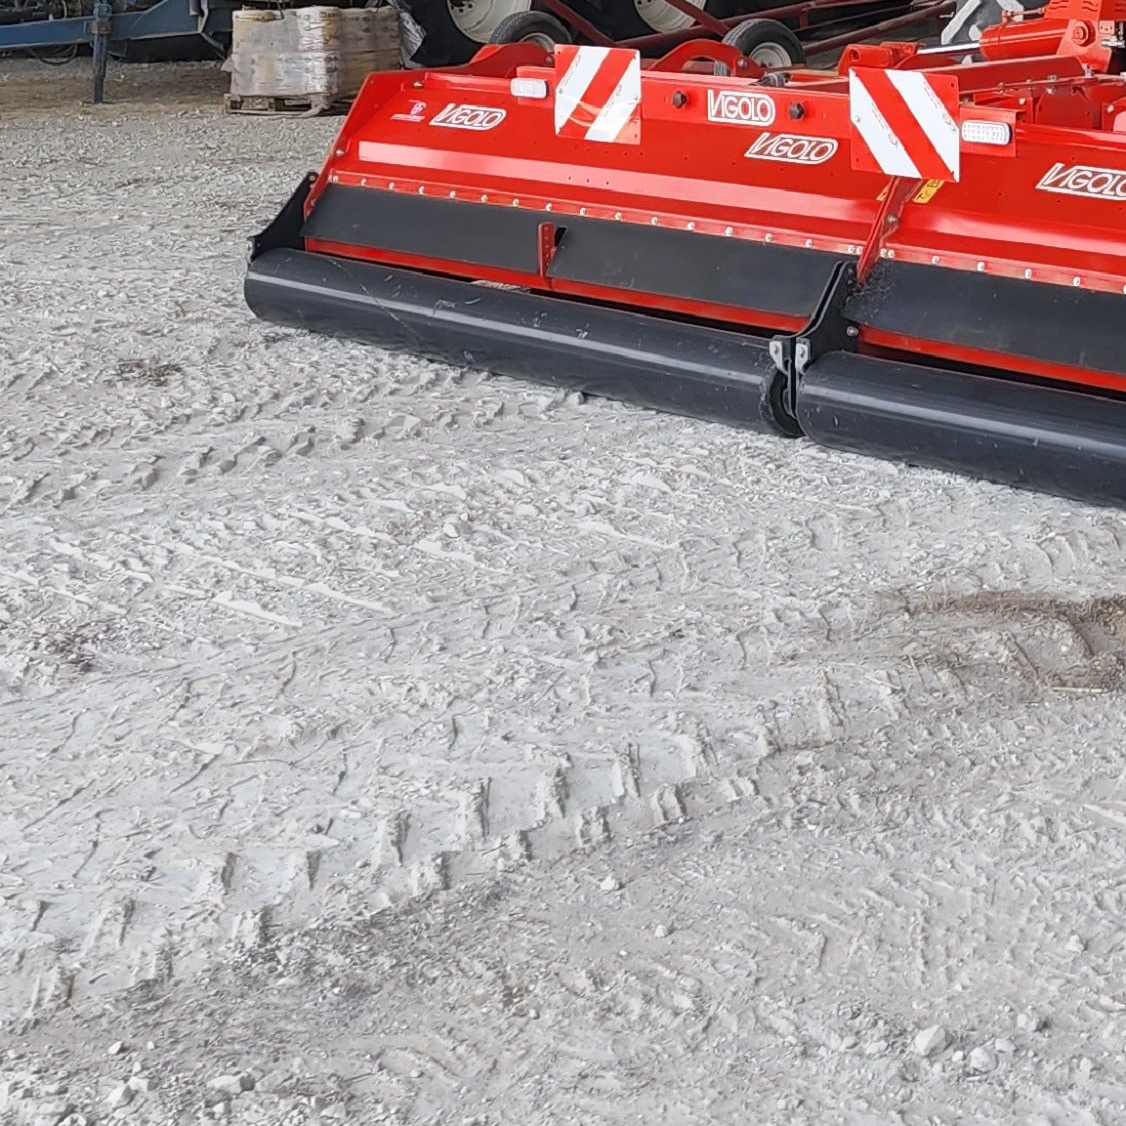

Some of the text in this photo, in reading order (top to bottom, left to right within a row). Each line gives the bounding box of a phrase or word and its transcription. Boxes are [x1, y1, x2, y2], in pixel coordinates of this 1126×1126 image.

[431, 103, 504, 130] VIGOLO
[708, 89, 774, 124] VIGOLO
[746, 132, 836, 163] VIGOLO
